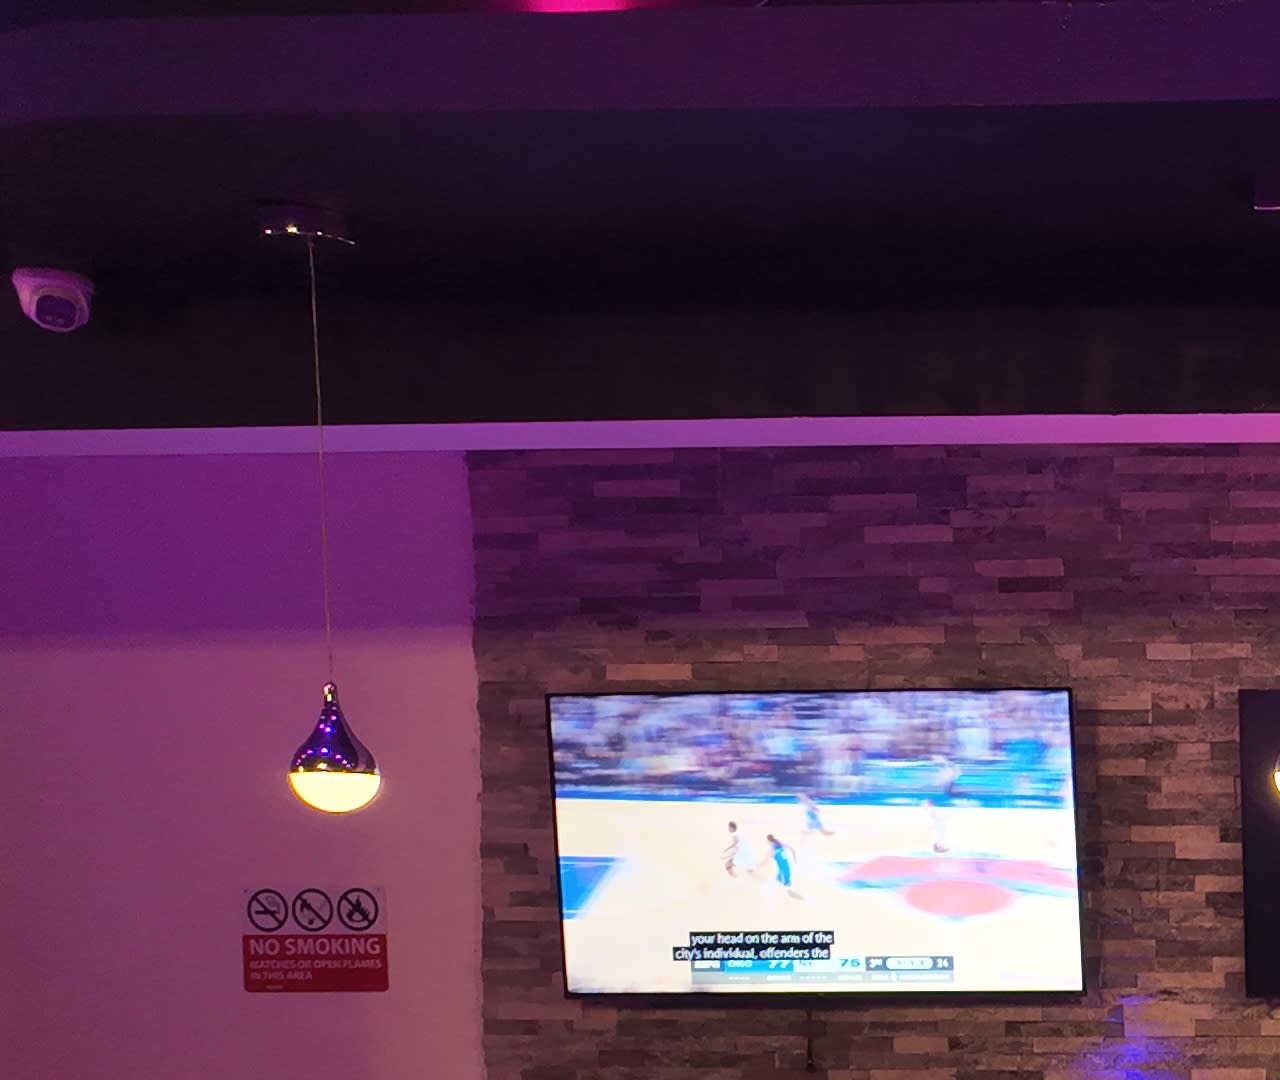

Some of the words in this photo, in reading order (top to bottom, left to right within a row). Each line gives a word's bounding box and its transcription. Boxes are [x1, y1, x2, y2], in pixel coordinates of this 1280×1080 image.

[691, 934, 716, 945] your
[717, 933, 743, 944] head
[745, 935, 760, 944] on
[761, 933, 779, 944] the
[780, 935, 800, 943] arm
[802, 932, 814, 943] of
[815, 932, 833, 943] the
[251, 939, 280, 955] NO
[285, 938, 381, 955] SMOKING
[675, 947, 702, 960] city's
[703, 947, 758, 960] individual,
[759, 947, 810, 959] offenders
[811, 948, 829, 958] the
[297, 960, 313, 969] OR
[314, 960, 341, 969] OPEN
[342, 959, 382, 969] FLAMES
[768, 959, 790, 969] 77
[839, 958, 861, 967] 75
[251, 971, 261, 980] IN
[262, 971, 285, 980] THIS
[286, 971, 313, 980] AREA
